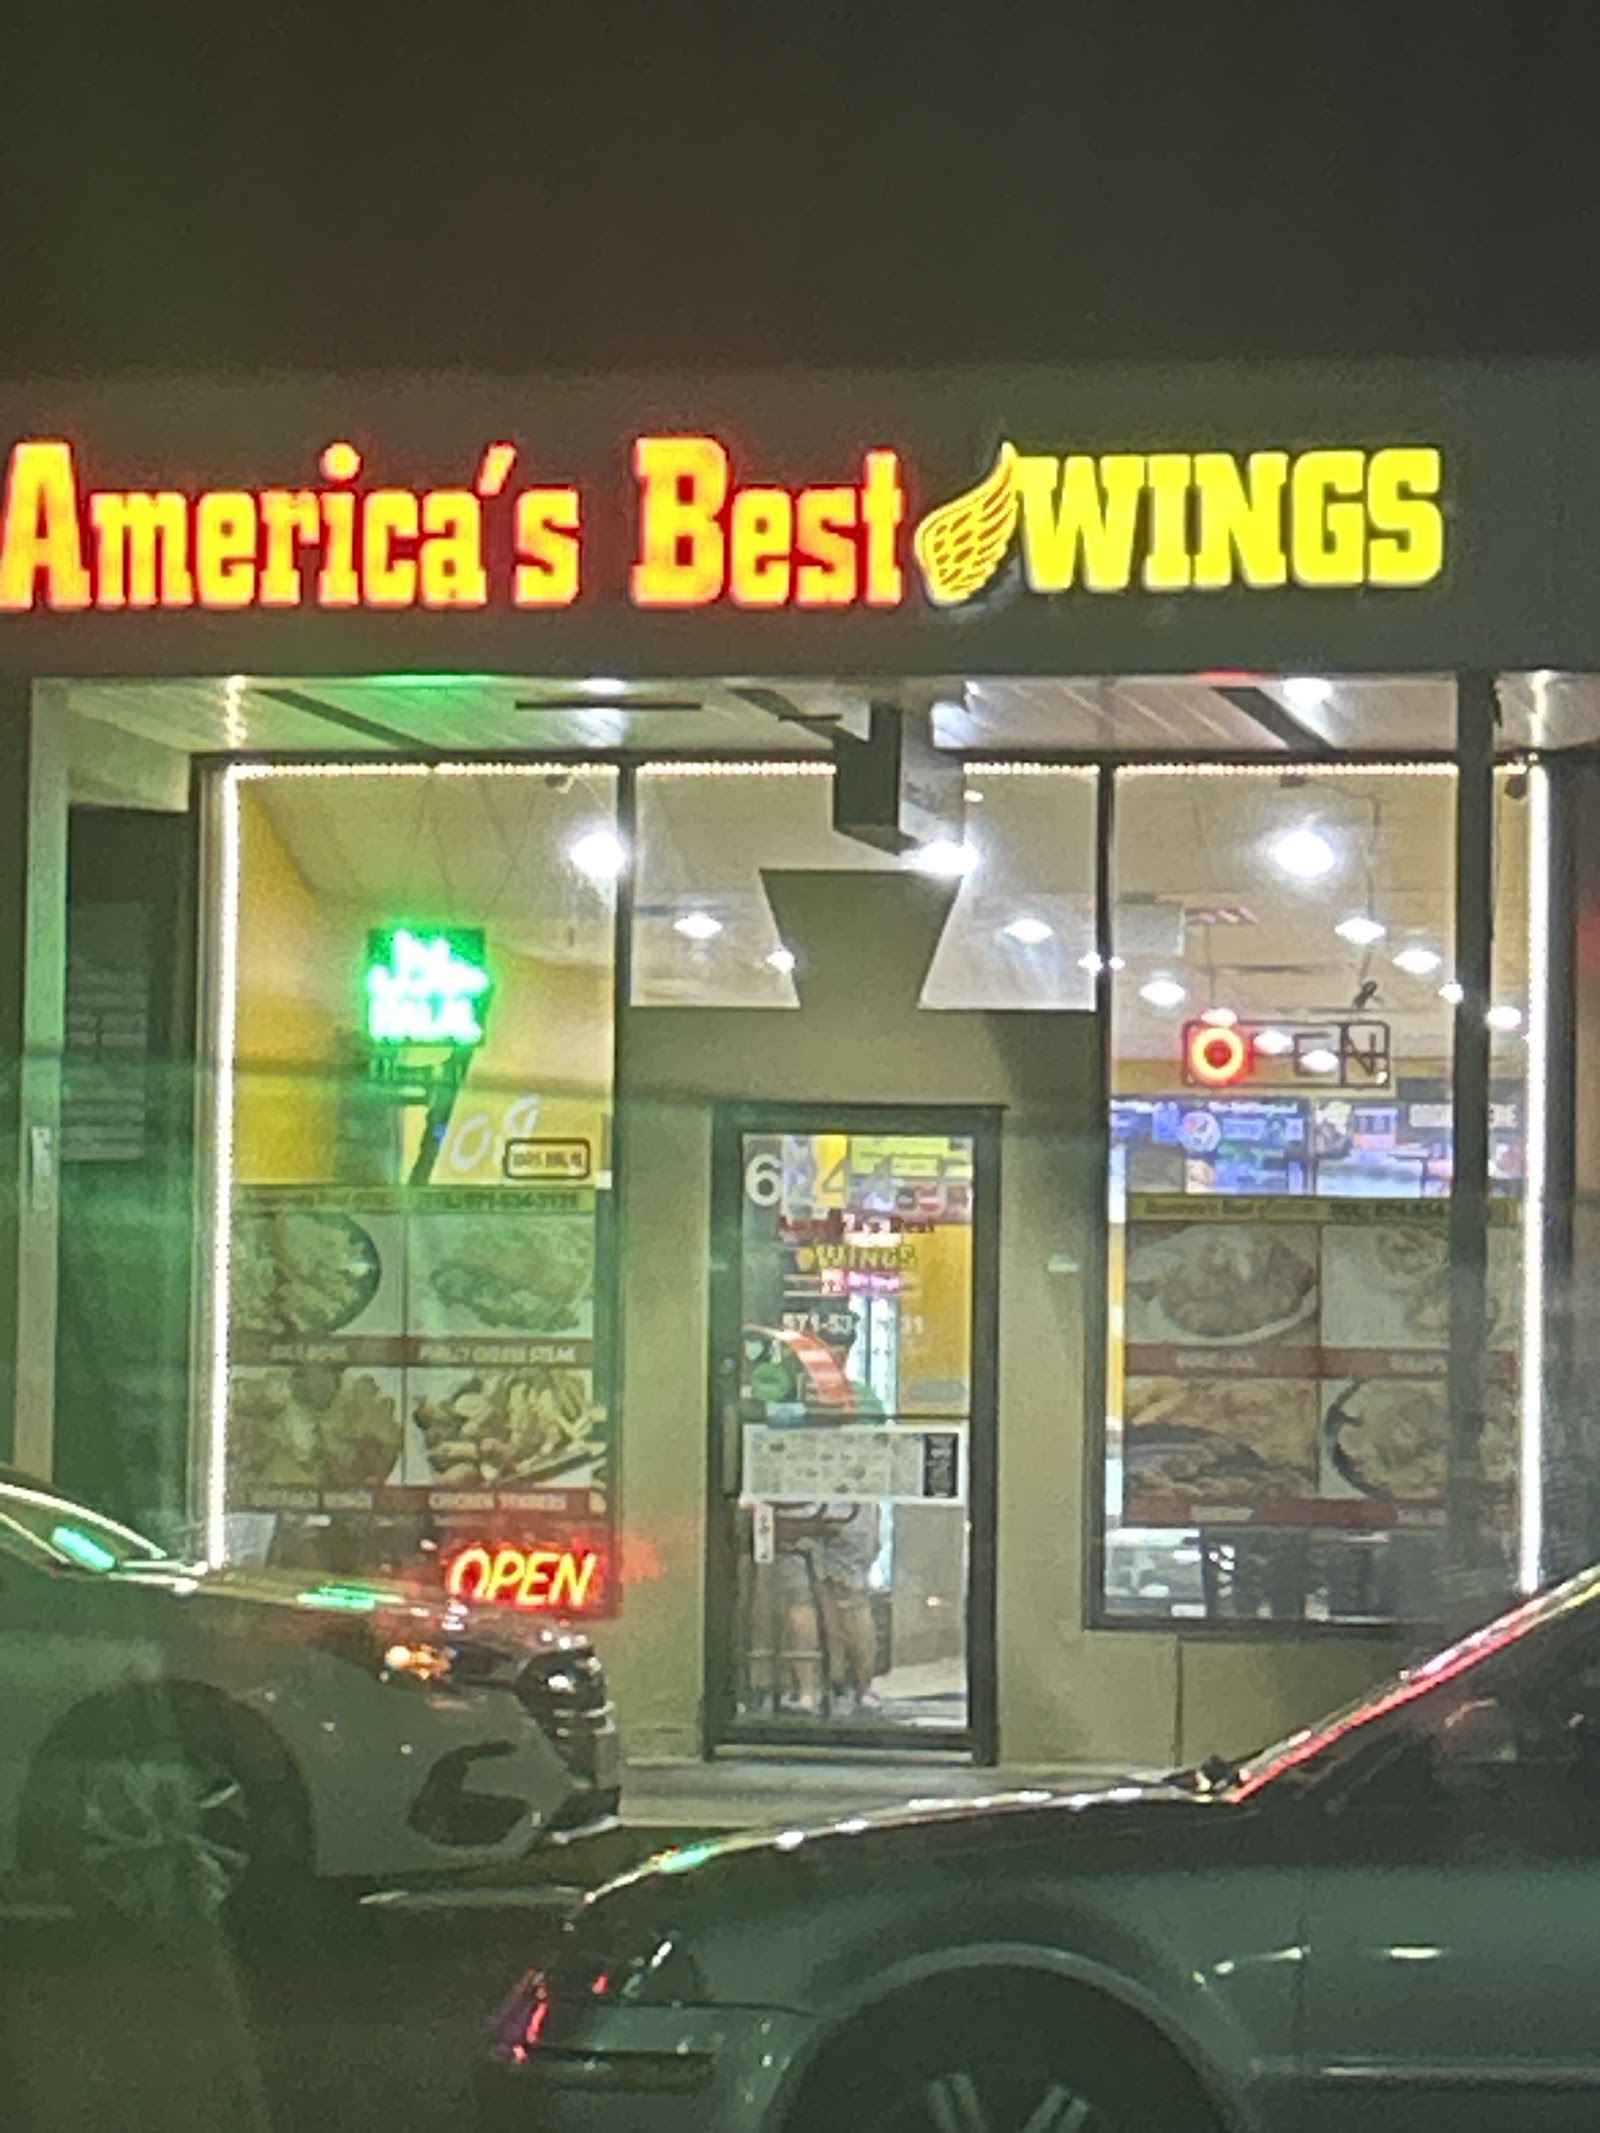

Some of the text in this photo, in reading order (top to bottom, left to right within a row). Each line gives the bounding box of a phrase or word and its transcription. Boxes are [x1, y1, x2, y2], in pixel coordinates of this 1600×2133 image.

[0, 436, 902, 608] America's Best
[1014, 447, 1444, 591] WINGS
[1188, 1025, 1379, 1083] OEN
[450, 1548, 597, 1607] OPEN
